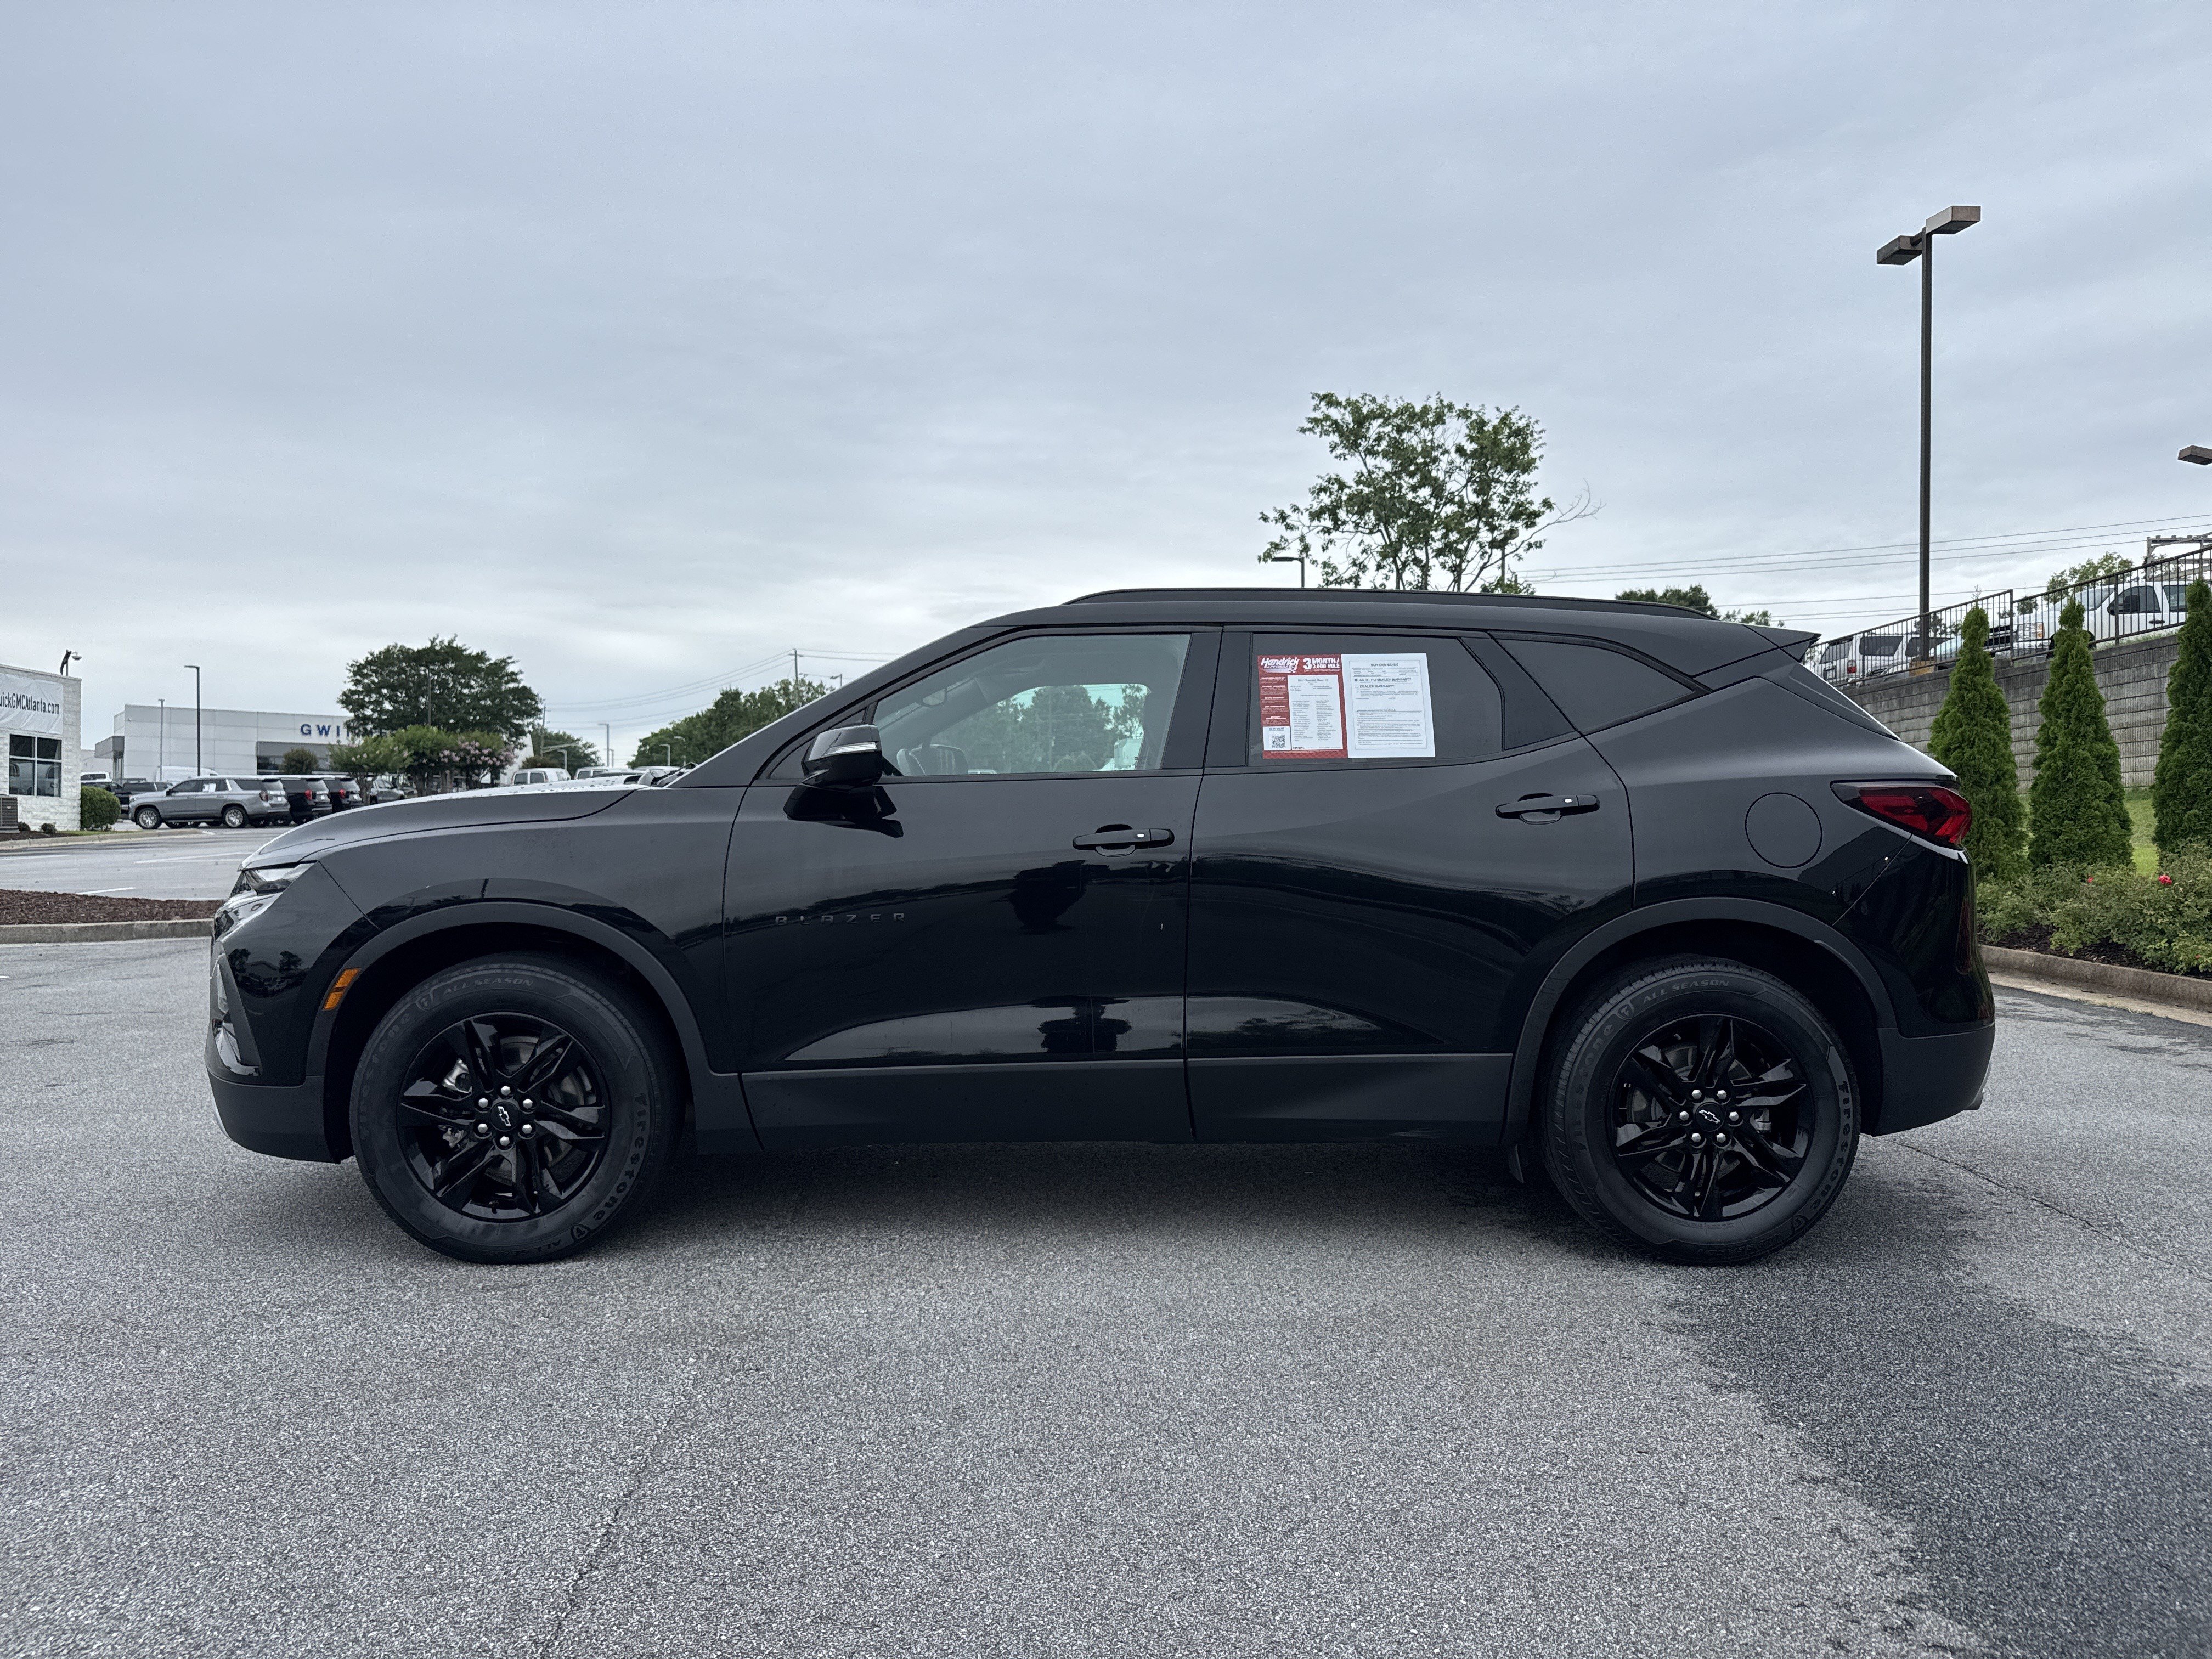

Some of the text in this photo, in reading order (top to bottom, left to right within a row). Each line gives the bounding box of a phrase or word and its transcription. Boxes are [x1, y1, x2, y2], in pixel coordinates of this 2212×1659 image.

[1260, 657, 1300, 668] Hendrick
[1304, 657, 1312, 670] 3
[775, 912, 905, 926] BLAZER
[443, 977, 534, 996] ALL SEASON
[1643, 979, 1730, 1005] ALL SEASON
[1810, 1080, 1852, 1210] Firestone
[593, 1092, 648, 1221] Firestone
